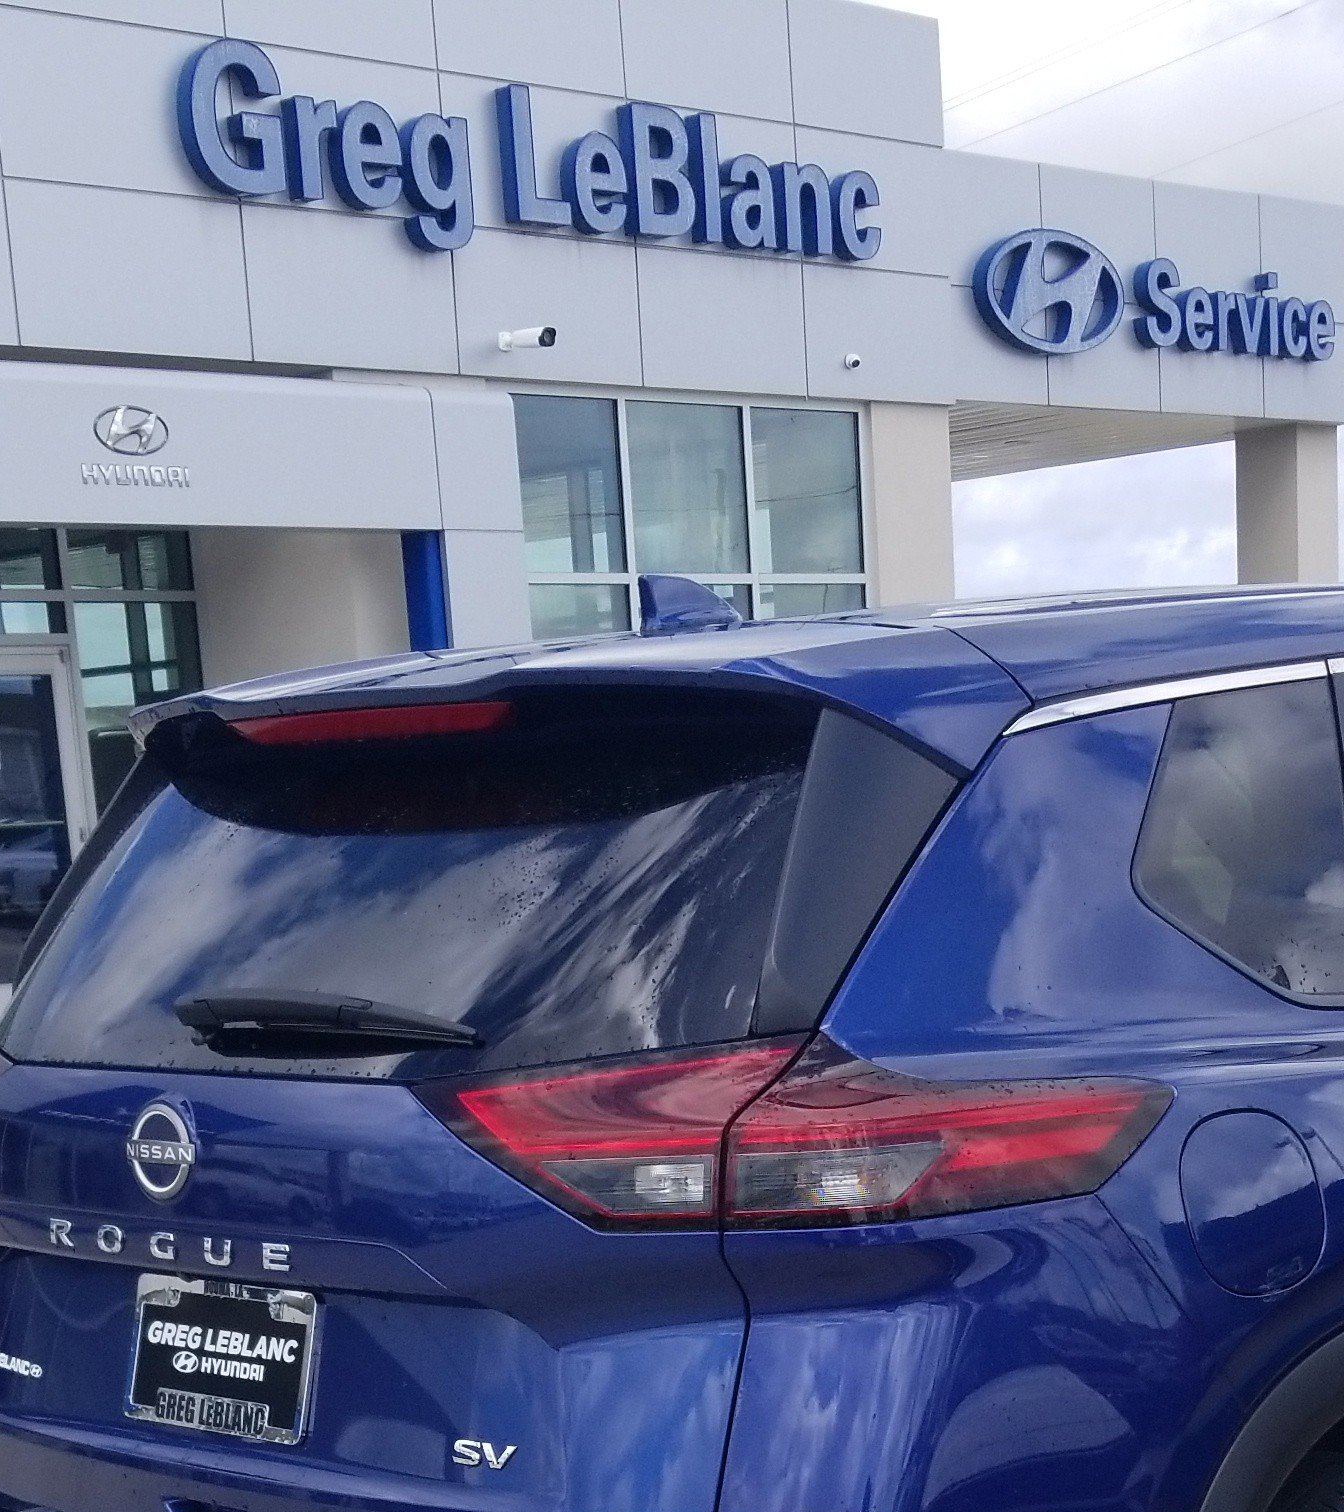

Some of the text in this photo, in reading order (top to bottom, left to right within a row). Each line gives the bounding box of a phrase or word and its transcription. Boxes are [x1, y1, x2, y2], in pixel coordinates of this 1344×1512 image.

[177, 37, 882, 261] Greg LeBlanc
[1133, 257, 1335, 361] Service
[81, 463, 190, 488] HYUNDAI
[126, 1141, 195, 1165] NISSAN
[49, 1217, 291, 1272] ROGUE
[147, 1320, 298, 1363] GREG LEBLANC
[200, 1356, 265, 1382] HYUNDAI
[156, 1391, 196, 1424] GREG
[452, 1438, 517, 1471] SV
